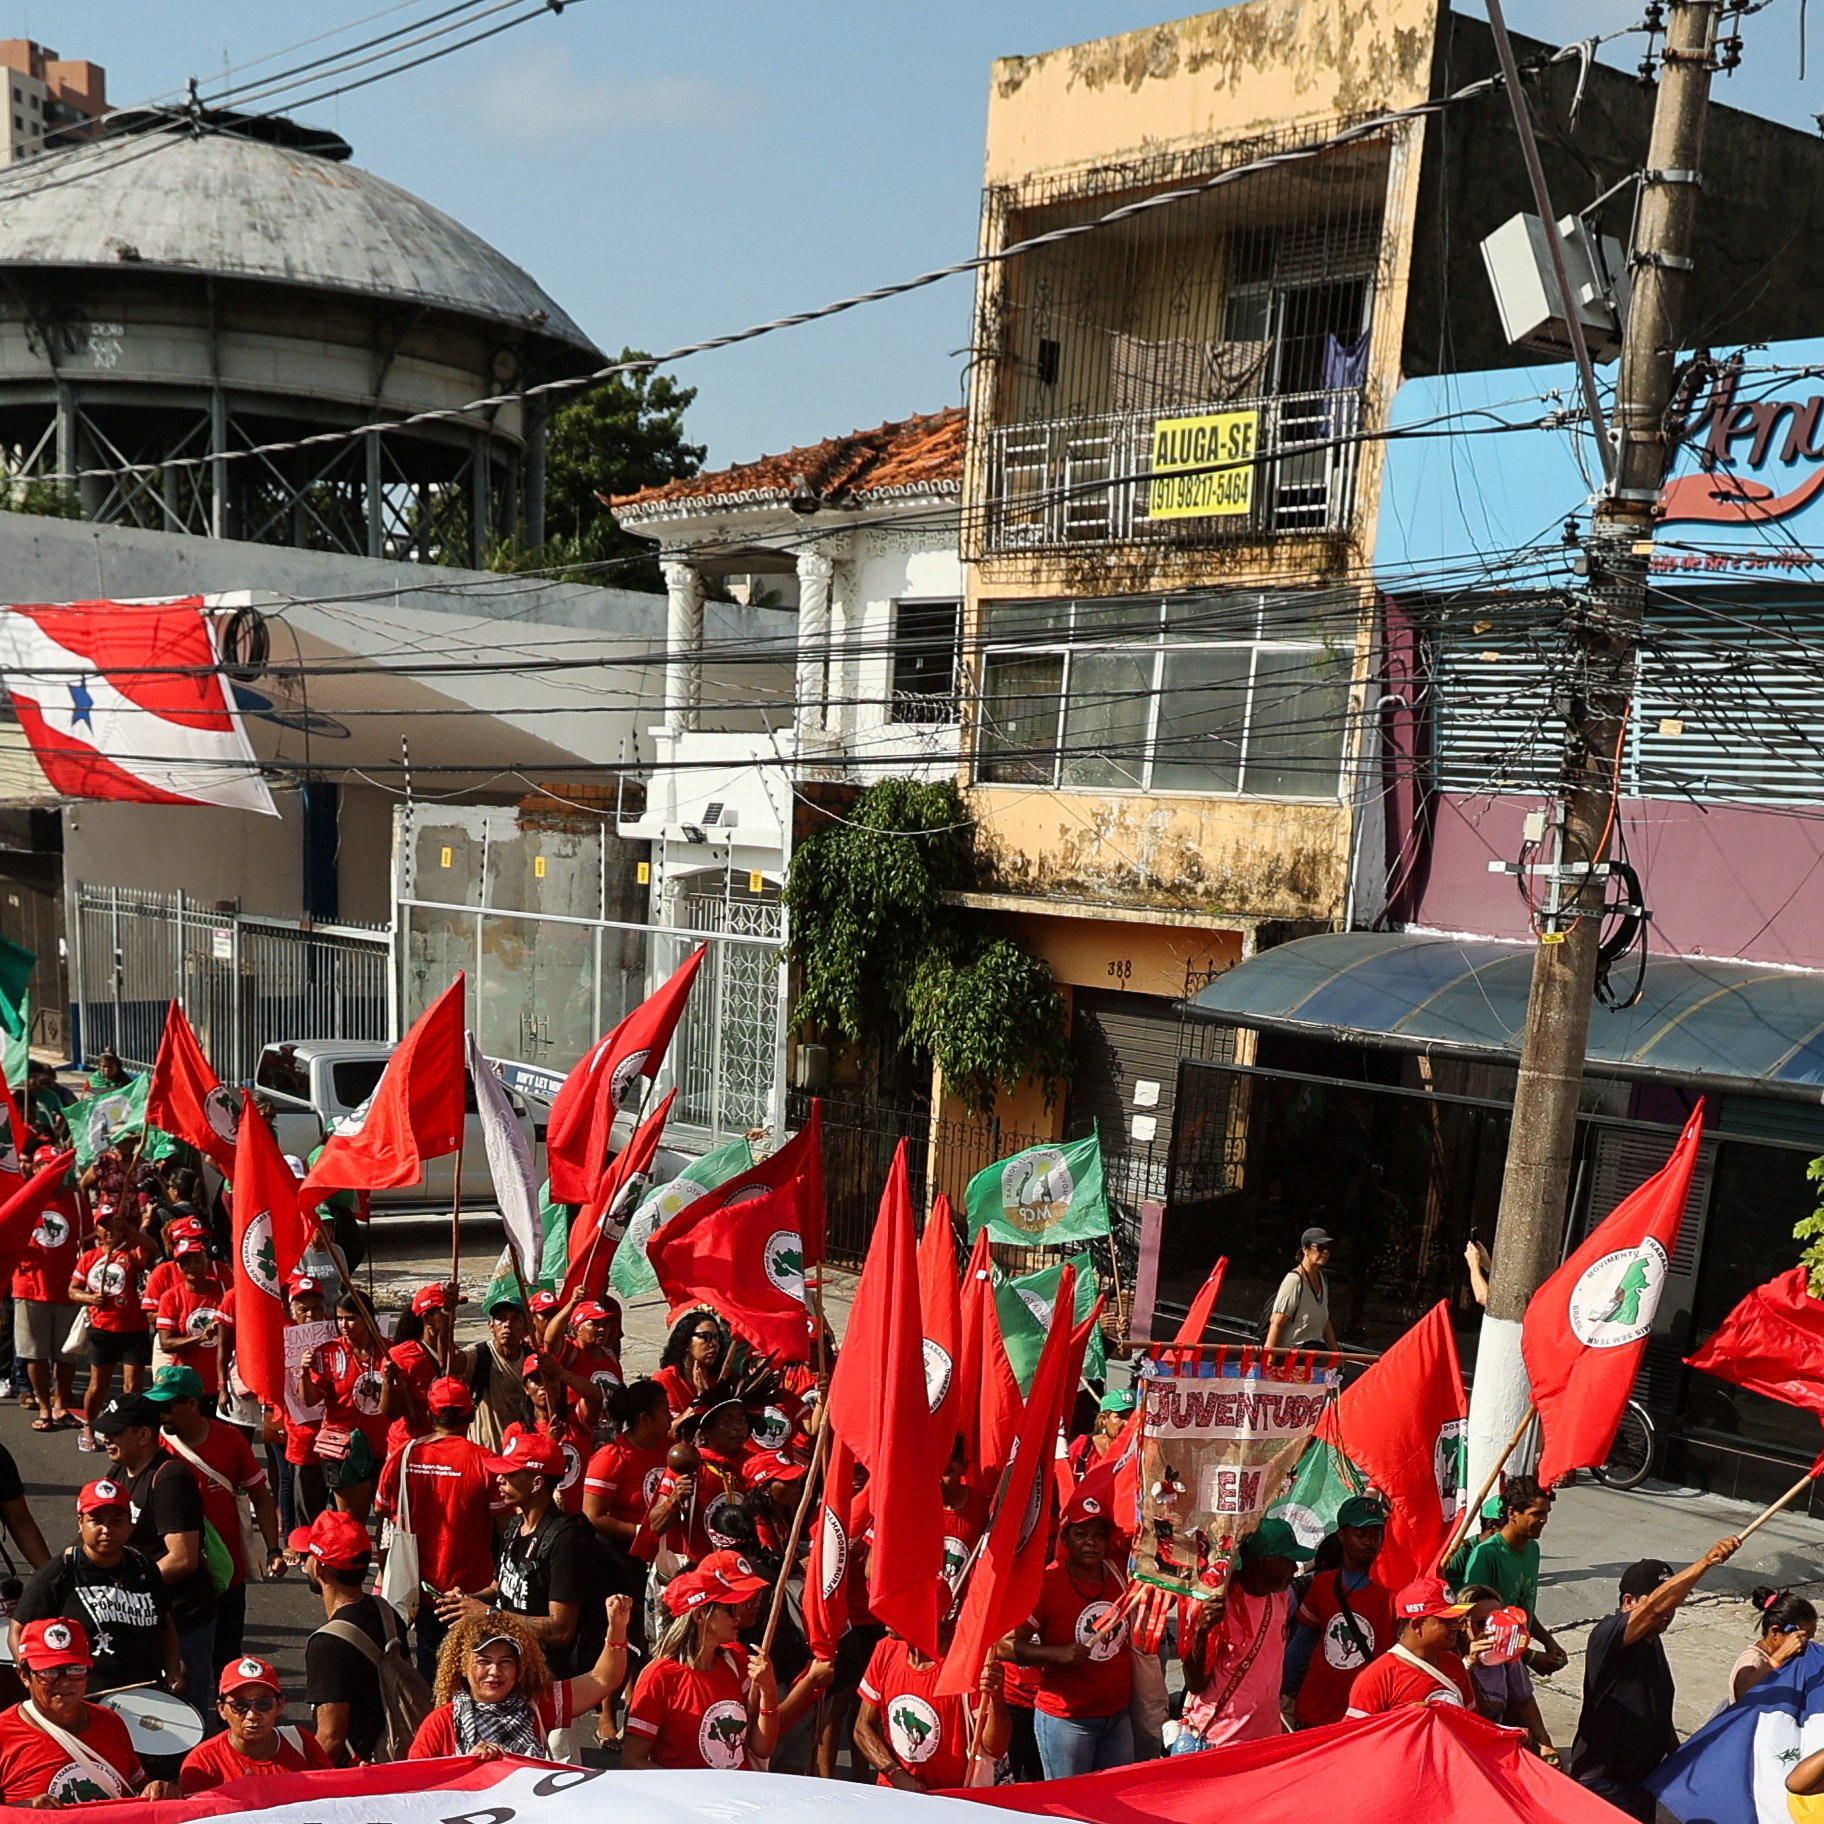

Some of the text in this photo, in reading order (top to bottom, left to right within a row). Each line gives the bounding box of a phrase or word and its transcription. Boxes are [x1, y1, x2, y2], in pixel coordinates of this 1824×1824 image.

[1155, 423, 1251, 466] ALUGA-SE
[1107, 959, 1132, 979] 388
[1586, 1251, 1640, 1280] MOVIMENTO
[1143, 1380, 1325, 1435] JUVENTUDE
[1217, 1471, 1261, 1513] EM
[79, 1585, 156, 1611] LEVANTE
[1405, 1603, 1425, 1613] MST
